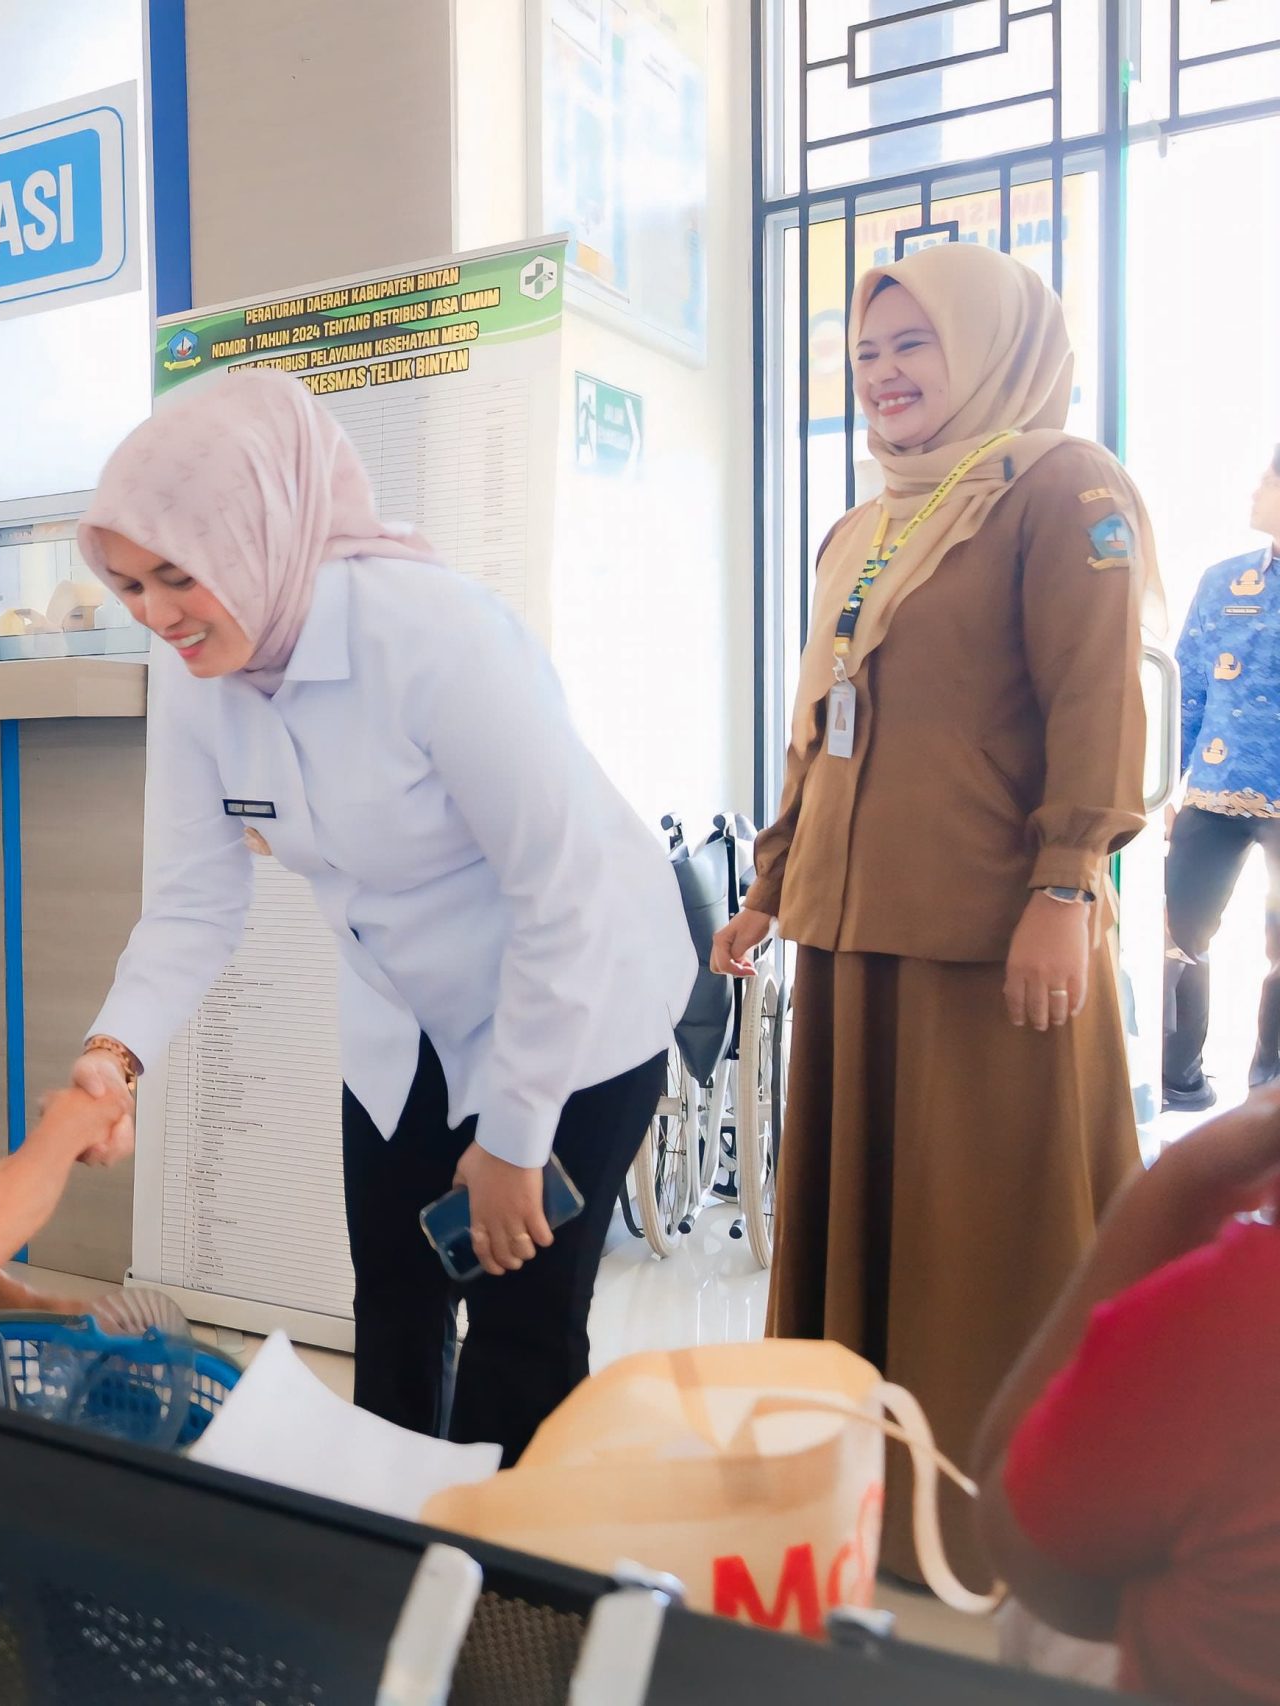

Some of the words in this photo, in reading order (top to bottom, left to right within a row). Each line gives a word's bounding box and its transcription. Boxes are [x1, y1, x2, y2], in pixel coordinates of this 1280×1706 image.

[245, 301, 304, 325] PERATURAN
[306, 290, 349, 313] DAERAH
[351, 276, 415, 303] KABUPATEN
[417, 266, 460, 290] BINTAN
[212, 338, 246, 359] NOMOR
[249, 336, 254, 351] 1
[256, 329, 290, 350] TAHUN
[292, 324, 320, 343] 2024
[323, 313, 370, 337] TENTANG
[373, 302, 428, 328] RETRIBUSI
[430, 296, 459, 317] JASA
[461, 288, 500, 312] UMUM
[310, 342, 372, 367] PELAYANAN
[374, 331, 439, 356] KESEHATAN
[441, 322, 479, 345] MEDIS
[301, 366, 366, 395] SKESMAS
[369, 359, 413, 385] TELUK
[415, 349, 469, 378] BINTAN
